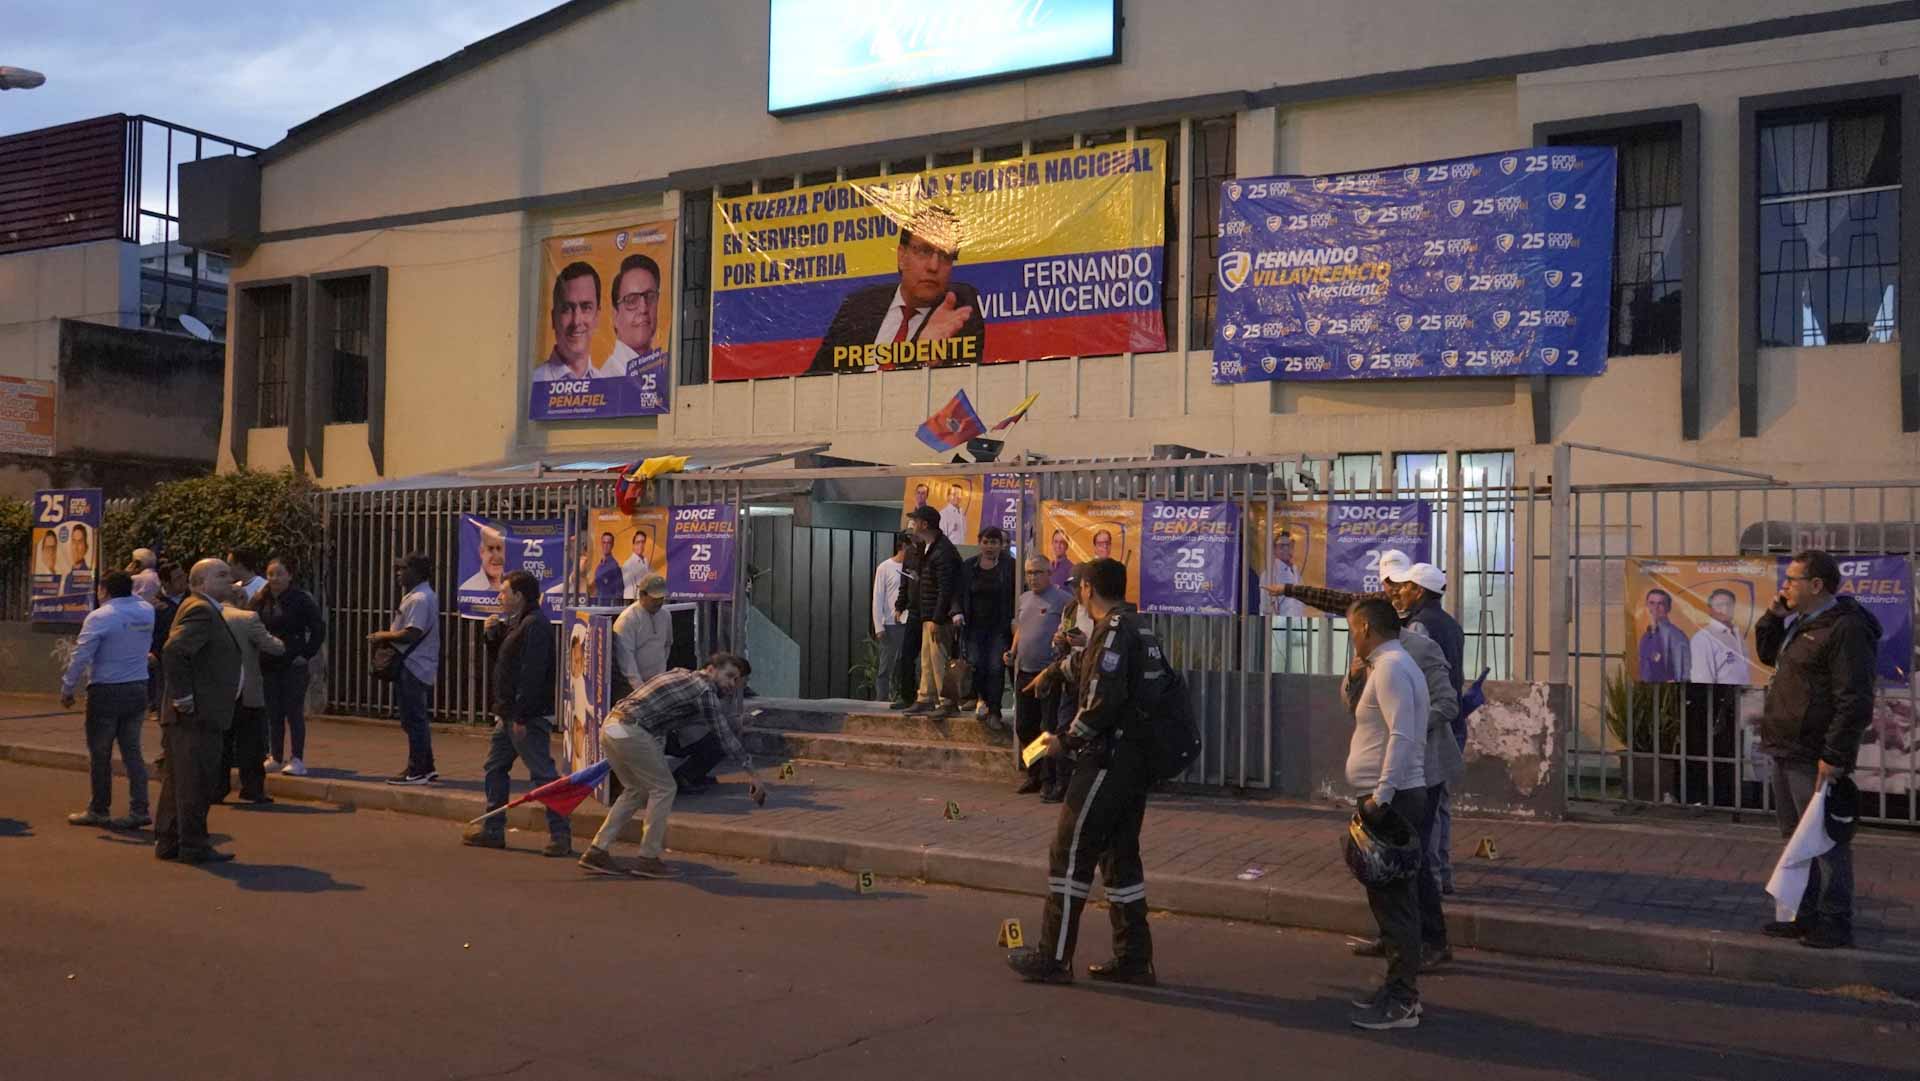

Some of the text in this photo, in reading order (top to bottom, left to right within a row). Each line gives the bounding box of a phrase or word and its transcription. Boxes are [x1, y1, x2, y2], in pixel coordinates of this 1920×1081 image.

[1525, 155, 1548, 172] 25
[1427, 166, 1448, 181] 25
[723, 202, 742, 225] LA
[745, 195, 808, 222] FUERZA
[944, 172, 957, 196] Y
[960, 159, 1040, 194] POLICÍA
[1045, 147, 1153, 183] NACIONAL
[1248, 184, 1267, 199] 25
[1472, 199, 1494, 215] 25
[1574, 194, 1587, 210] 2
[1288, 215, 1308, 231] 25
[723, 214, 898, 256] EN SERVICIO PASIVO
[1522, 233, 1544, 249] 25
[1424, 240, 1445, 256] 25
[1254, 246, 1358, 269] FERNANDO
[723, 253, 847, 287] POR LA PATRIA
[1023, 252, 1152, 288] FERNANDO
[1253, 261, 1392, 287] VILLAVICENCIO
[1470, 275, 1491, 291] 25
[1571, 272, 1583, 288] 2
[976, 268, 1154, 320] VILLAVICENCIO
[1420, 315, 1441, 330] 25
[1518, 310, 1541, 327] 25
[1242, 324, 1260, 338] 25
[833, 335, 977, 368] PRESIDENTE
[1465, 351, 1487, 366] 25
[1567, 352, 1579, 366] 2
[1285, 357, 1302, 372] 25
[1370, 354, 1391, 369] 25
[549, 381, 590, 394] JORGE
[642, 373, 656, 391] 25
[547, 393, 607, 408] PEÑAFIEL
[40, 494, 64, 523] 25
[1005, 498, 1020, 513] 2
[1152, 505, 1211, 519] JORGE
[1338, 506, 1401, 520] JORGE
[675, 509, 716, 520] JORGE
[674, 519, 734, 533] PEÑAFIEL
[1152, 519, 1234, 535] PEÑAFIEL
[1338, 520, 1430, 537] PEÑAFIEL
[523, 539, 544, 557] 25
[691, 544, 712, 561] 25
[523, 560, 545, 570] cons
[1177, 547, 1205, 569] 25
[1365, 550, 1381, 571] 2
[689, 563, 710, 573] cons
[1174, 572, 1205, 581] cons
[1838, 580, 1905, 594] AFIEL
[1159, 604, 1184, 614] tiempo
[862, 872, 872, 887] 5
[1008, 923, 1019, 940] 6
